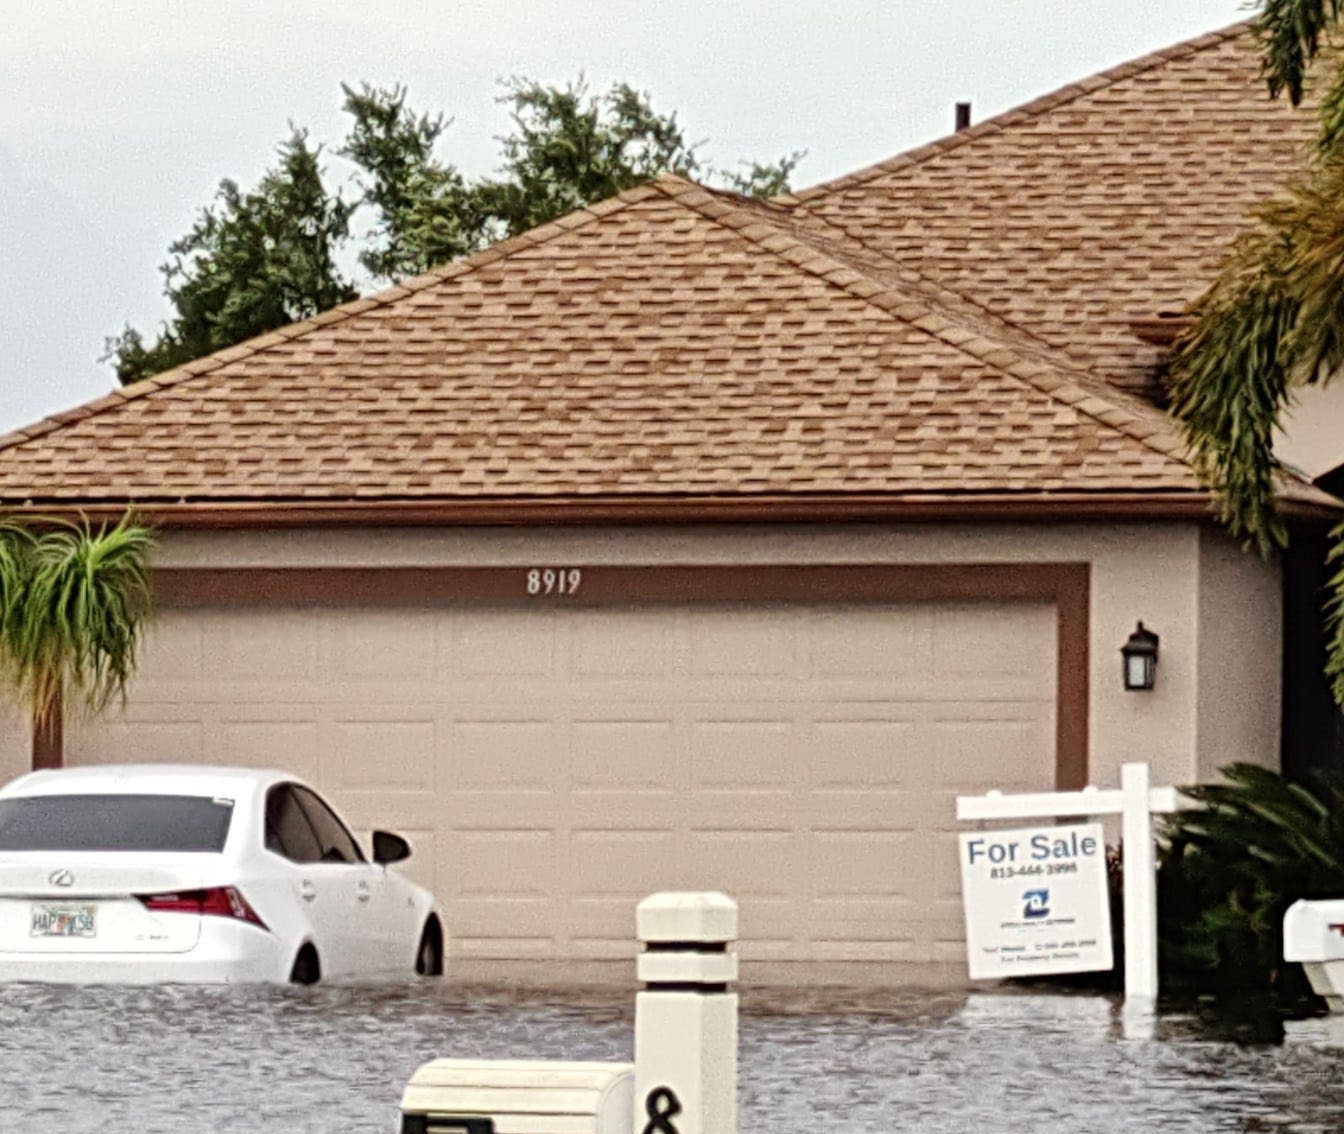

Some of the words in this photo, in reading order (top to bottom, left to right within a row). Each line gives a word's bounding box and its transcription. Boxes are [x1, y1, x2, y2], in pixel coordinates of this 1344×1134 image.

[527, 568, 581, 594] 8919
[967, 839, 1019, 865] For
[1030, 831, 1097, 860] Sale
